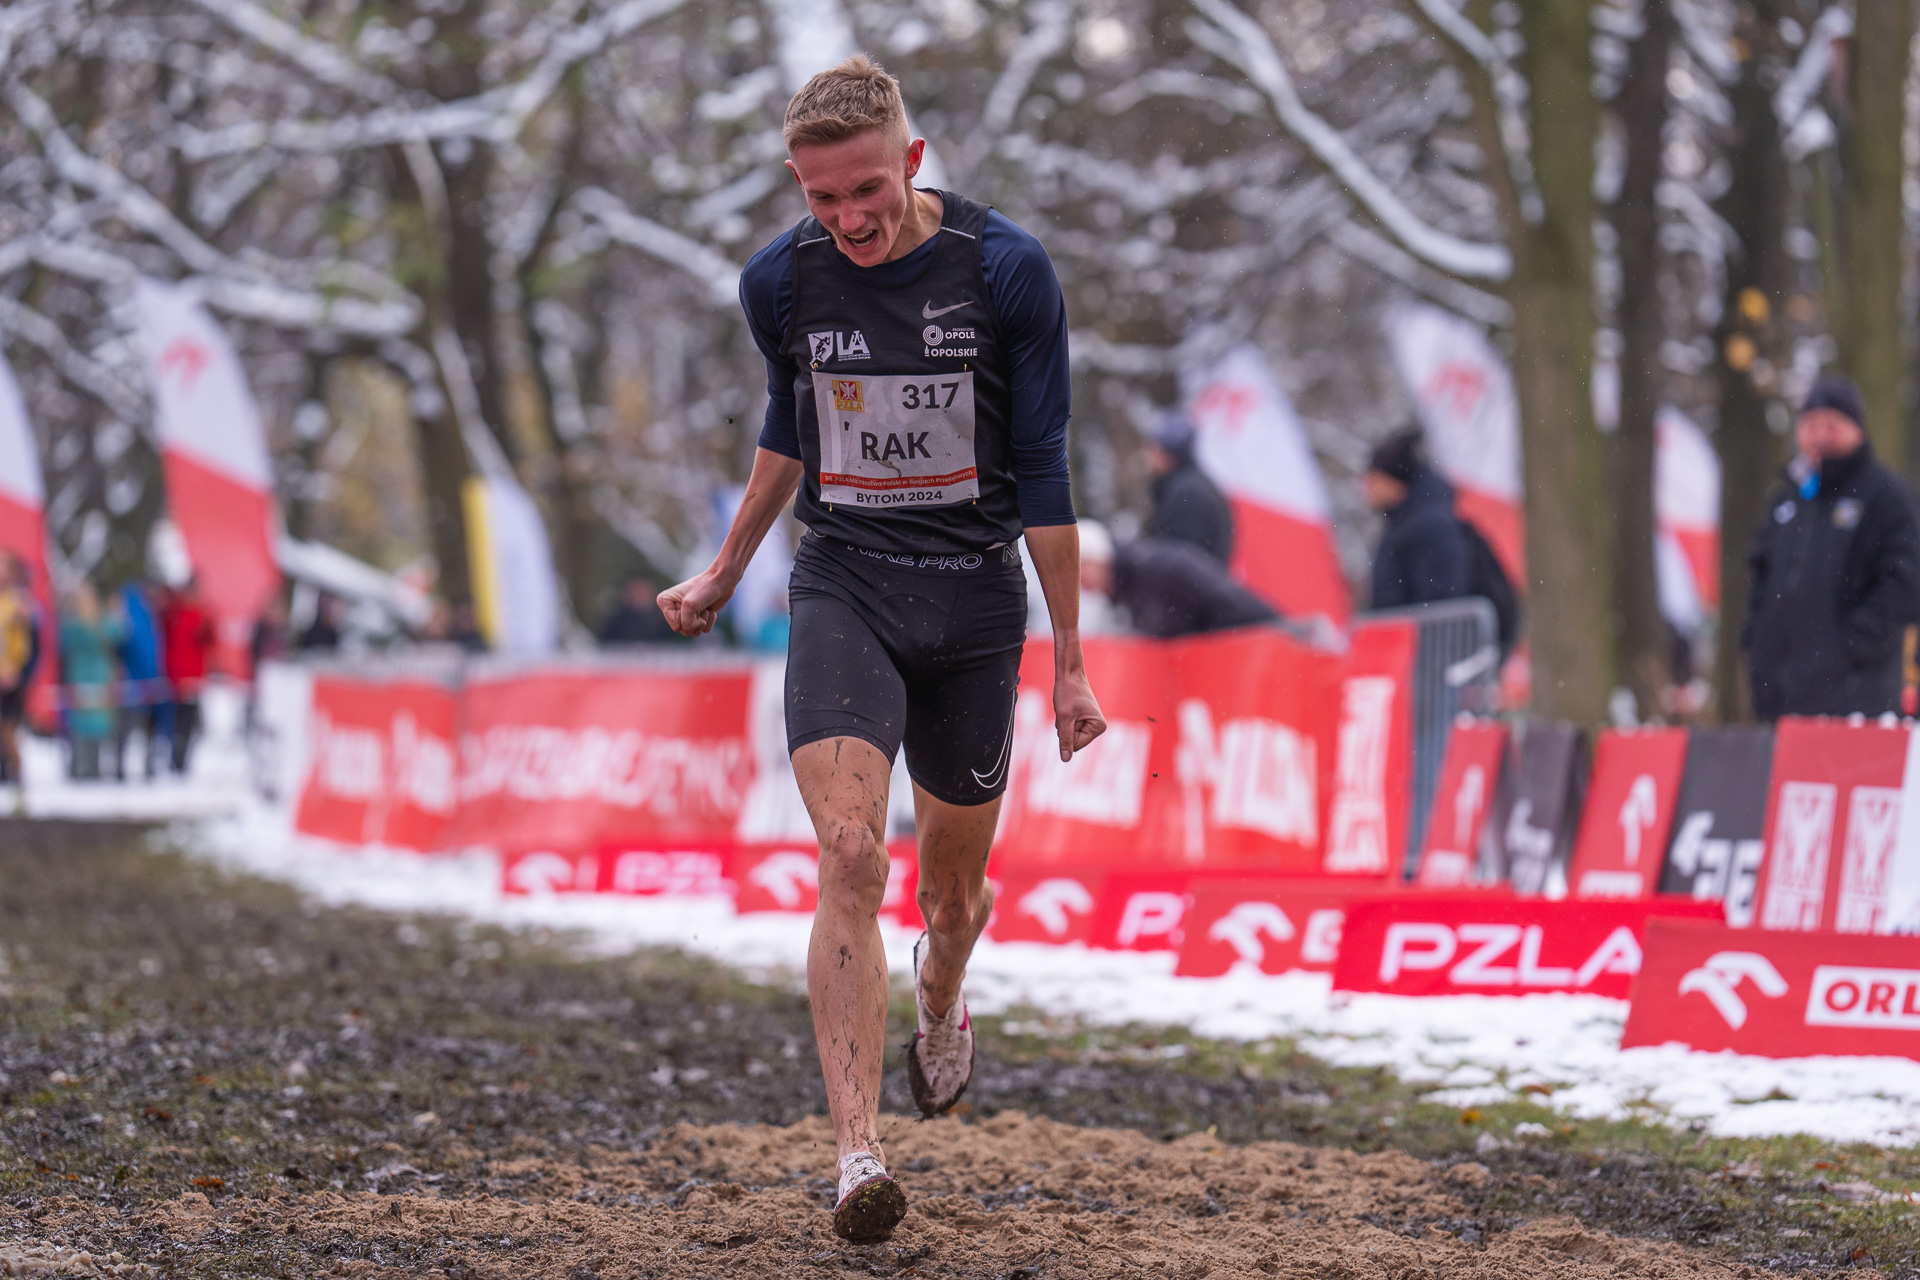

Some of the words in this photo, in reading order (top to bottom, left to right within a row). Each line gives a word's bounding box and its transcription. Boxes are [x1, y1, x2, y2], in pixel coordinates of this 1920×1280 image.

[945, 331, 976, 339] OPOLE
[930, 347, 978, 357] OPOLSKIE
[902, 382, 960, 410] 317
[838, 400, 863, 411] PZLA
[860, 431, 932, 461] RAK
[883, 479, 901, 487] Polski
[909, 477, 935, 486] Biegach
[856, 492, 905, 504] BYTOM
[908, 490, 943, 502] 2024
[919, 553, 983, 570] PRO
[1379, 922, 1643, 987] PZLA
